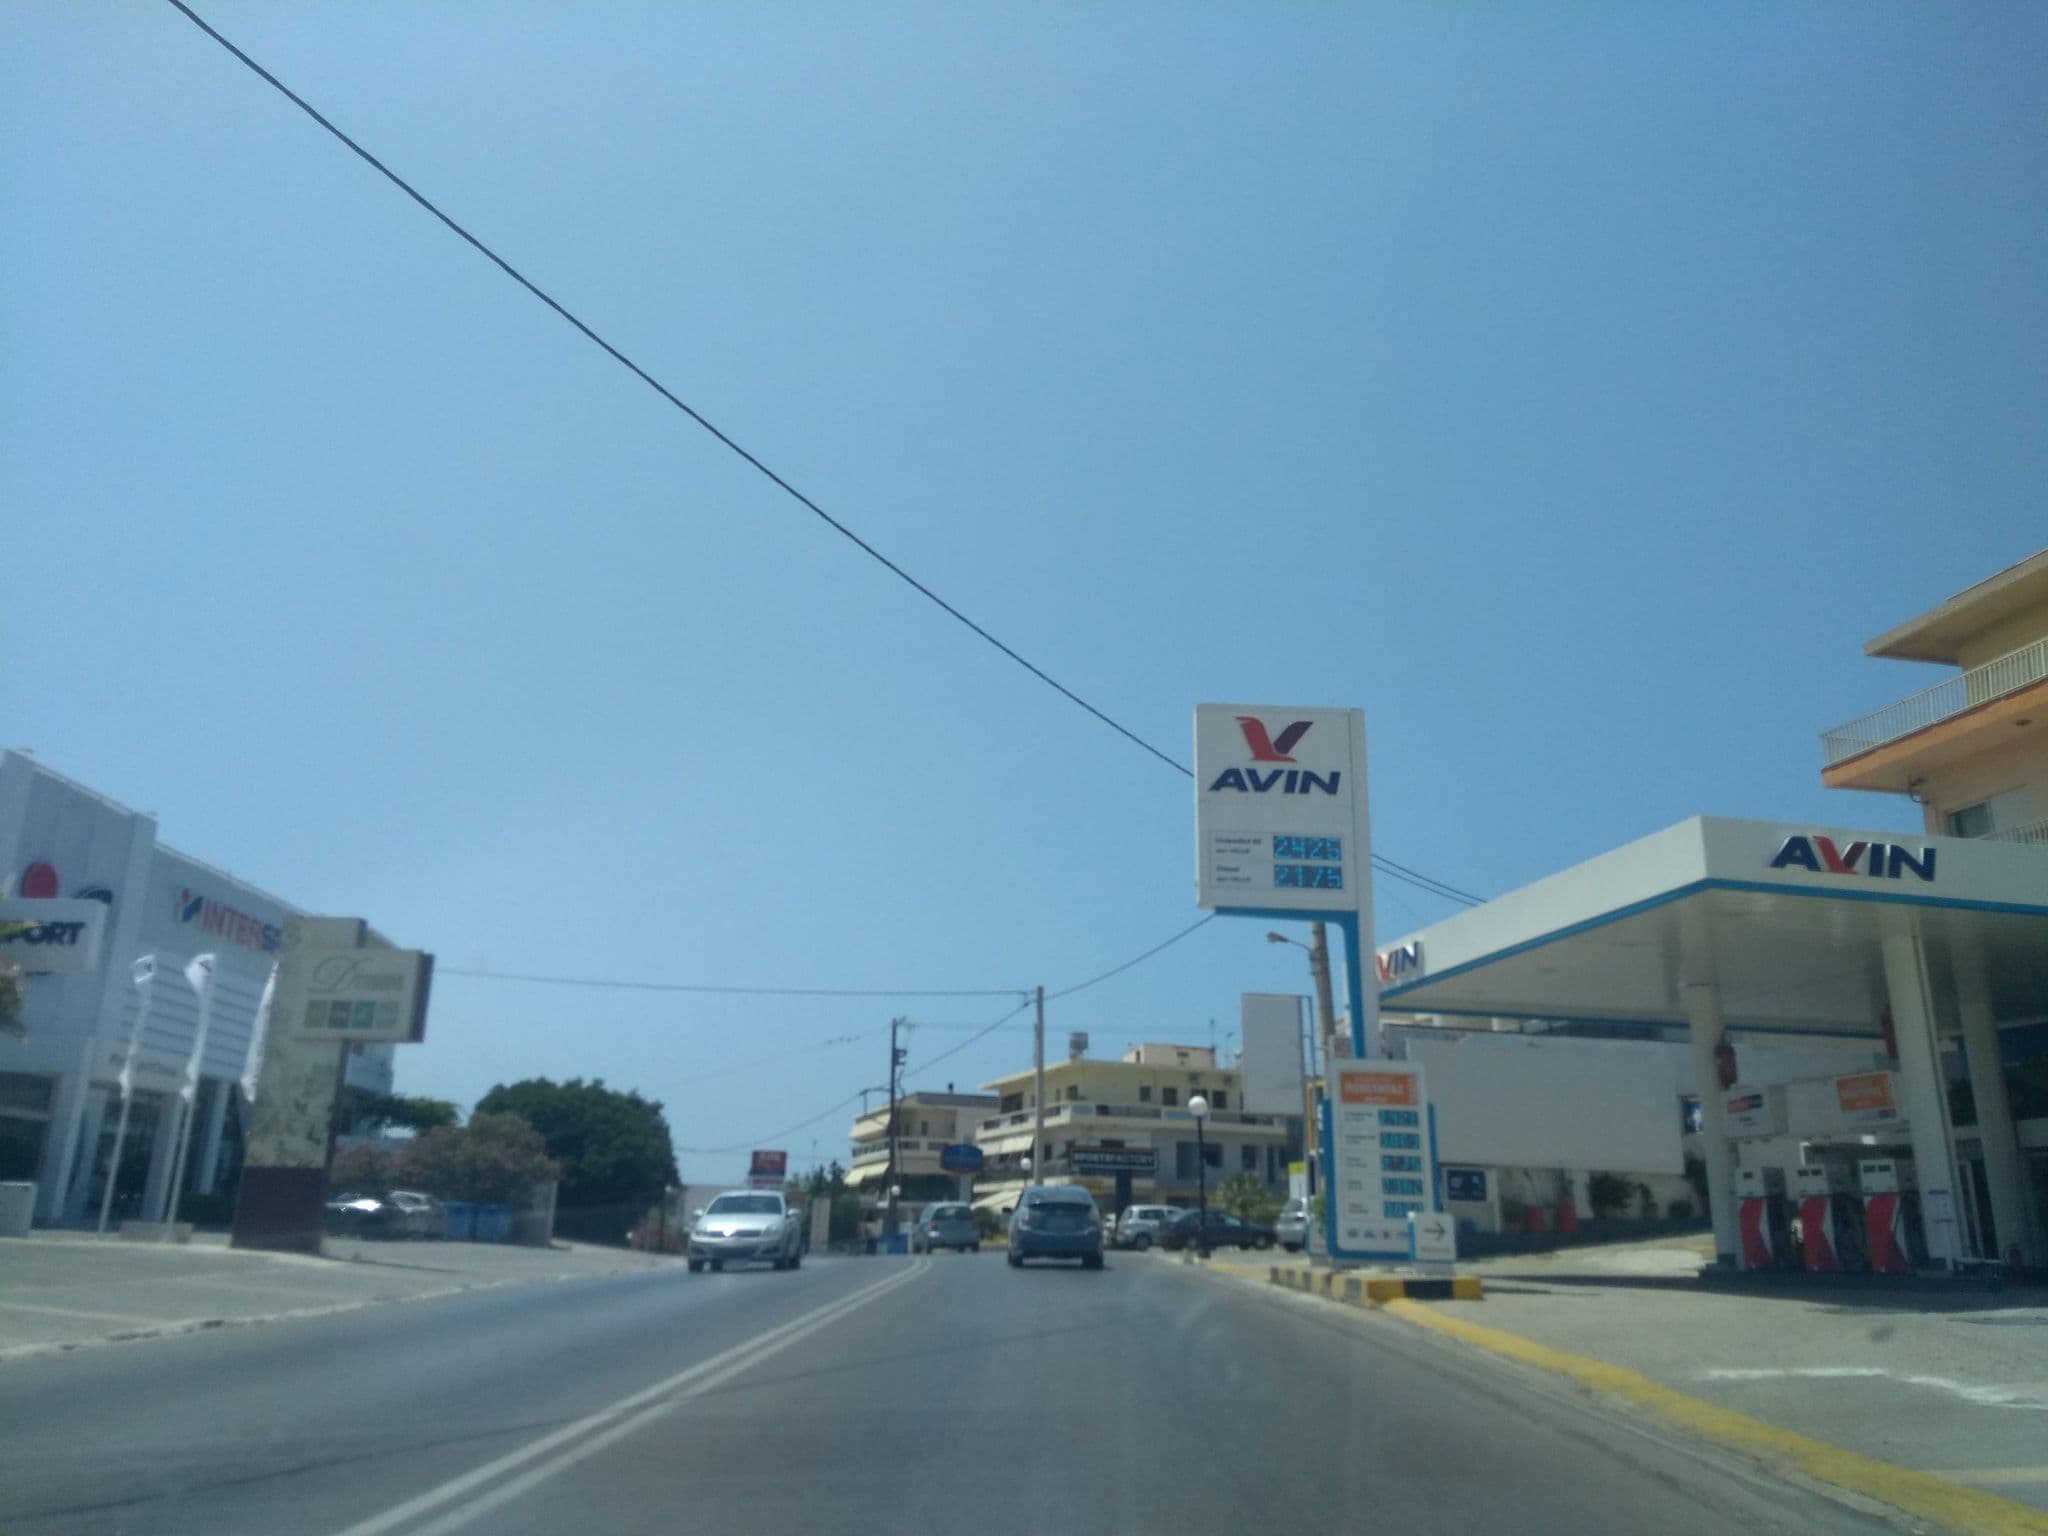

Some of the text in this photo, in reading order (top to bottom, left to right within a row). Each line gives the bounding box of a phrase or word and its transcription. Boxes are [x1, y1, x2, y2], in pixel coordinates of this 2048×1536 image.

[1209, 768, 1341, 795] AVIN
[1769, 834, 1937, 882] AVIN
[1375, 941, 1420, 980] VIN
